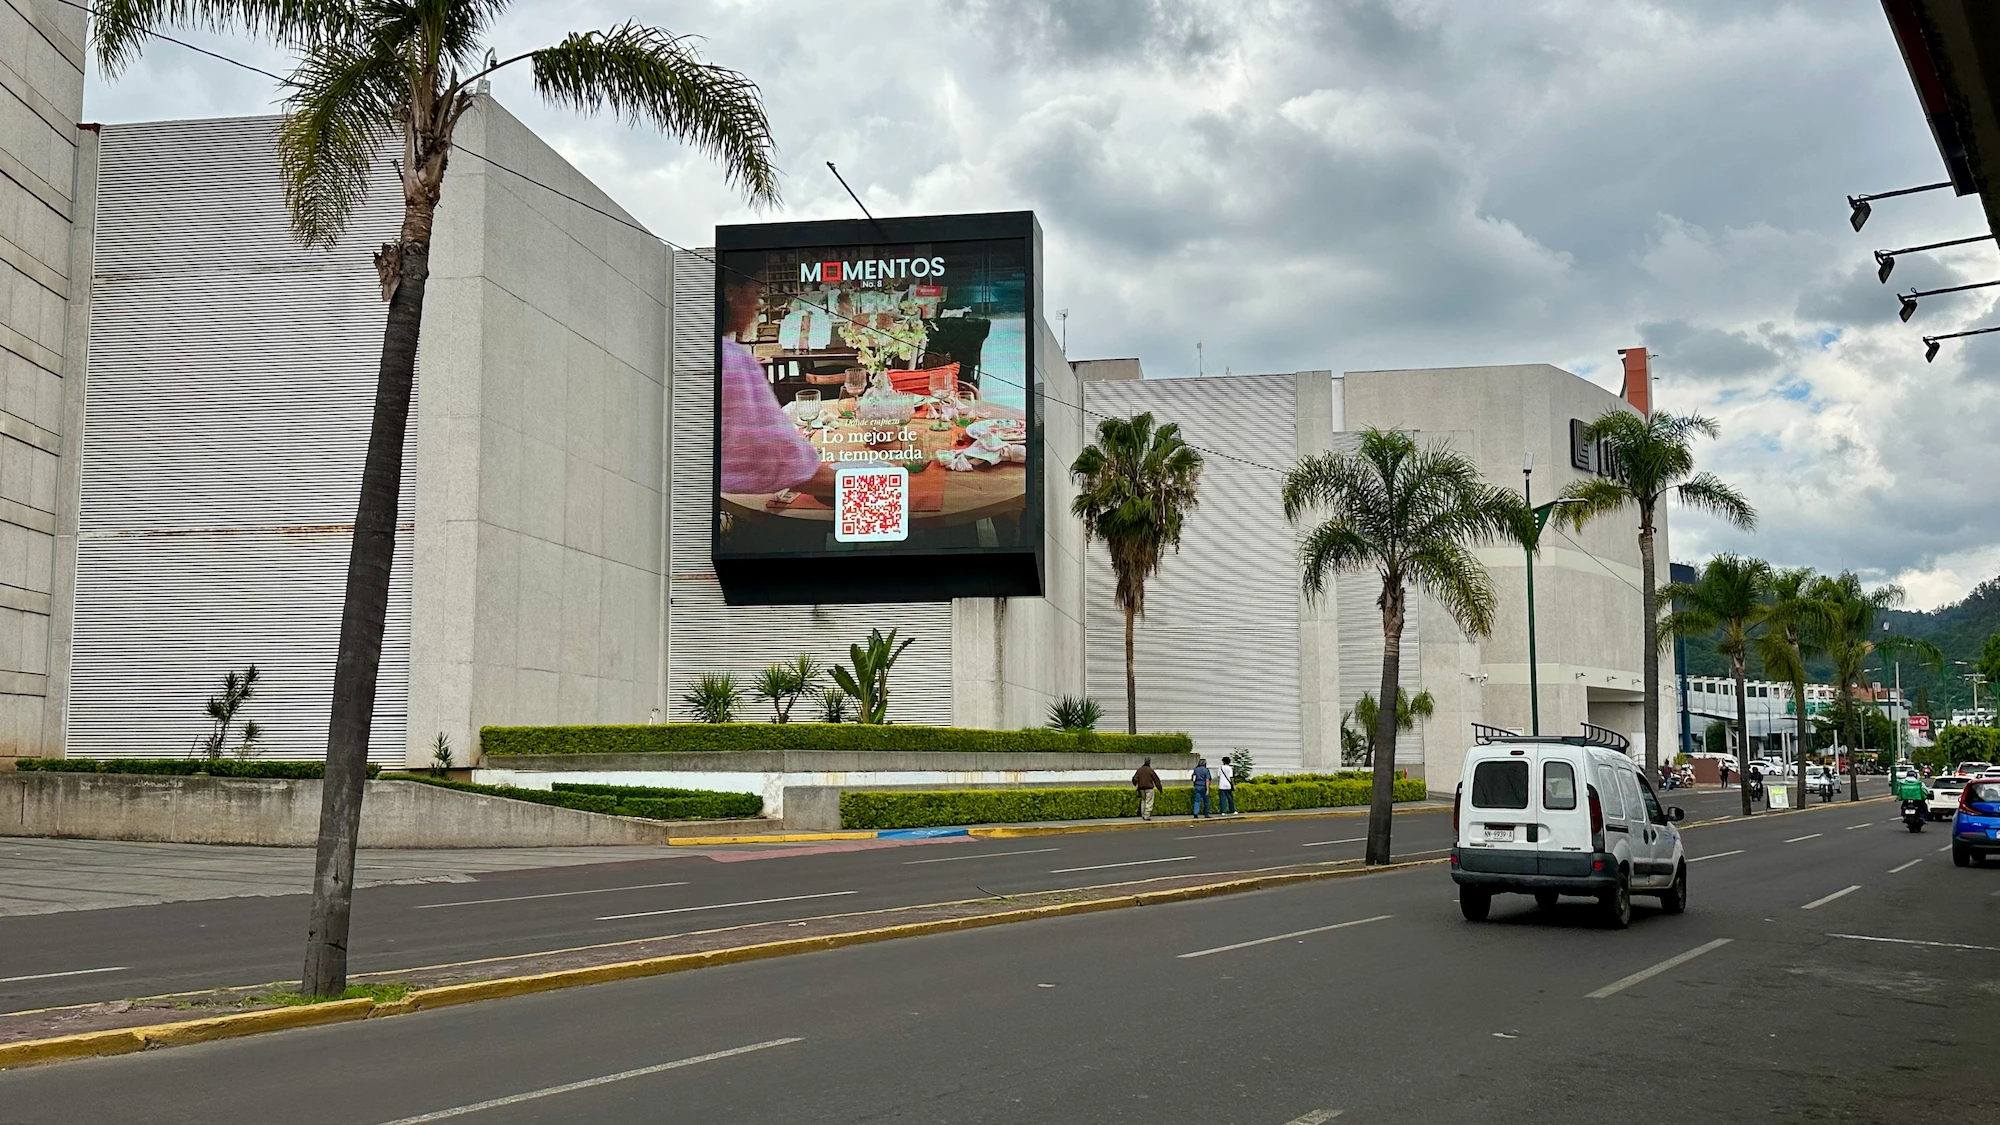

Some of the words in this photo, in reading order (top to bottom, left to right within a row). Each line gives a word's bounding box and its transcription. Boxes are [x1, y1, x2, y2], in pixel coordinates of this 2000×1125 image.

[800, 256, 946, 283] MOMENTOS
[822, 428, 844, 444] Lo
[848, 428, 894, 445] mejor
[897, 425, 917, 441] de
[820, 447, 836, 463] la
[839, 445, 923, 464] temporada
